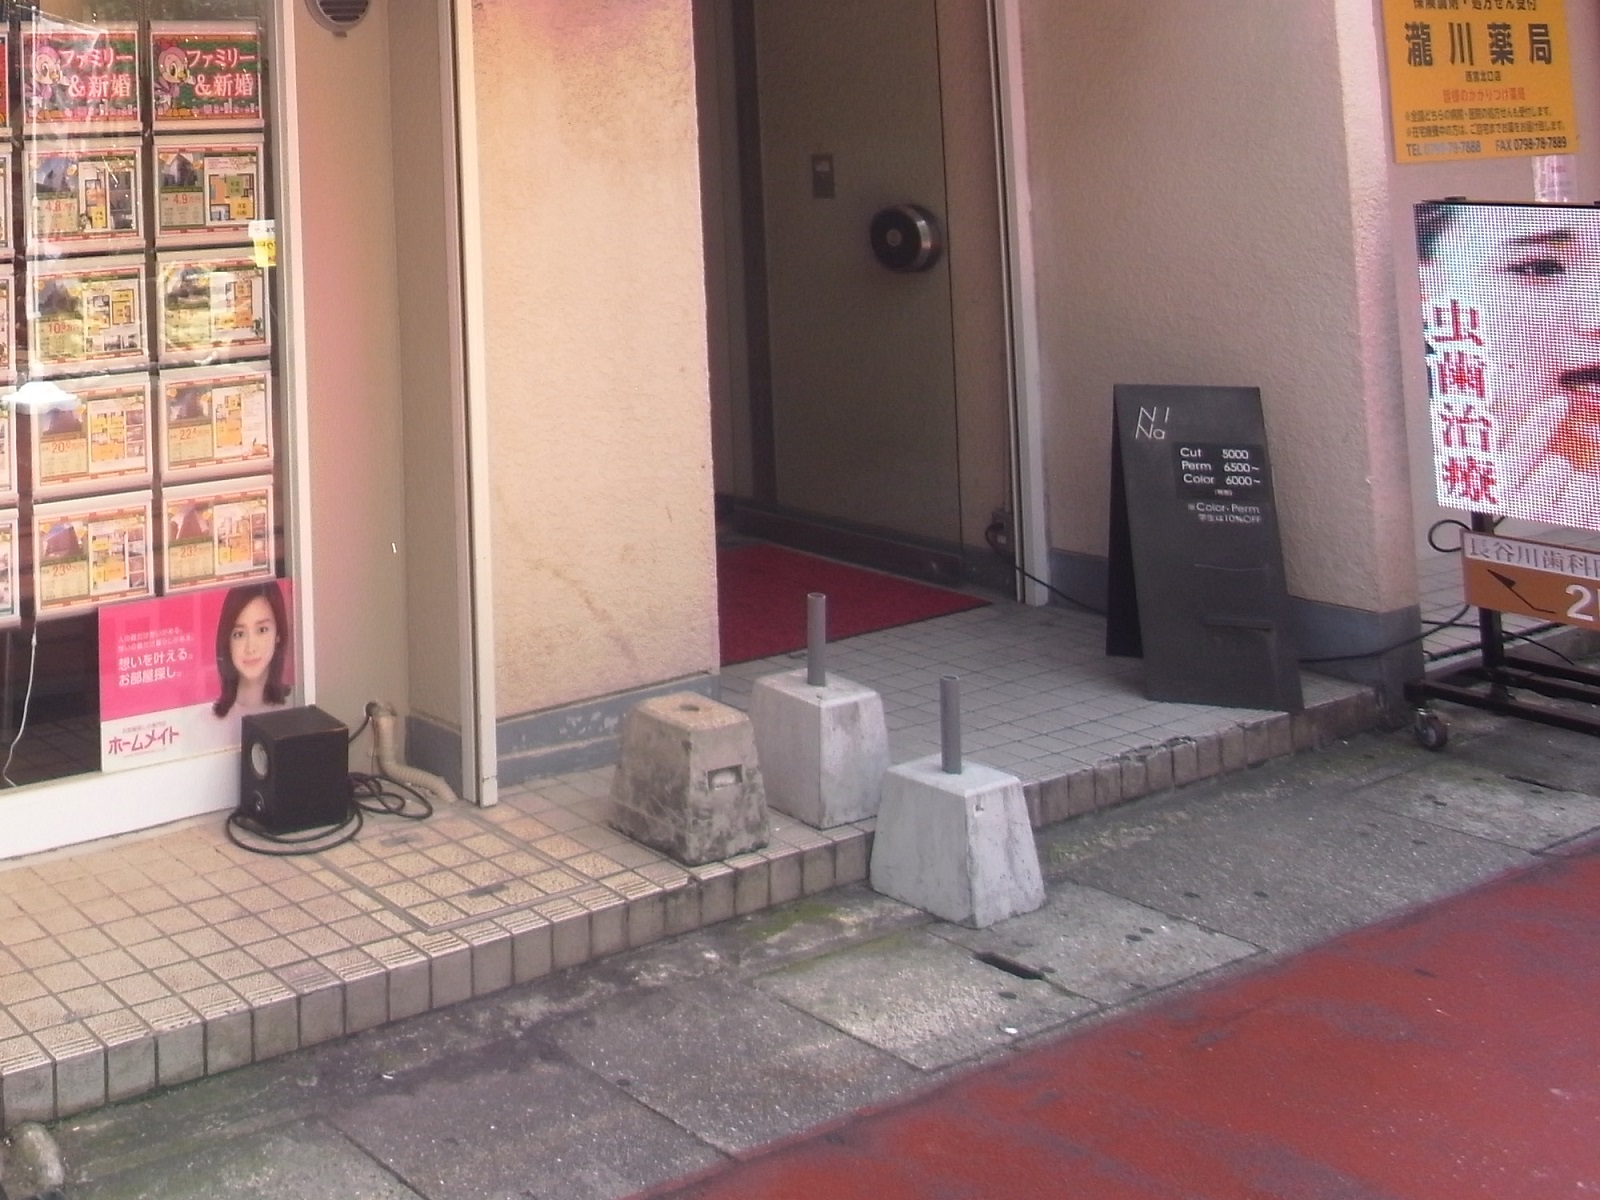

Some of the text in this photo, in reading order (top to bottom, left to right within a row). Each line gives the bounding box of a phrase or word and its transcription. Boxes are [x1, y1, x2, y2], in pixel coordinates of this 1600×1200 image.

[58, 45, 134, 70] ファミリー
[185, 46, 256, 70] ファミリー
[1431, 300, 1498, 506] 虫歯治療
[1180, 447, 1249, 460] Cut 5000
[1181, 460, 1212, 471] Perm
[1183, 473, 1215, 484] Color
[1470, 537, 1600, 578] 長谷川歯科
[1565, 584, 1600, 622] 2
[108, 725, 180, 755] ホームメイト
